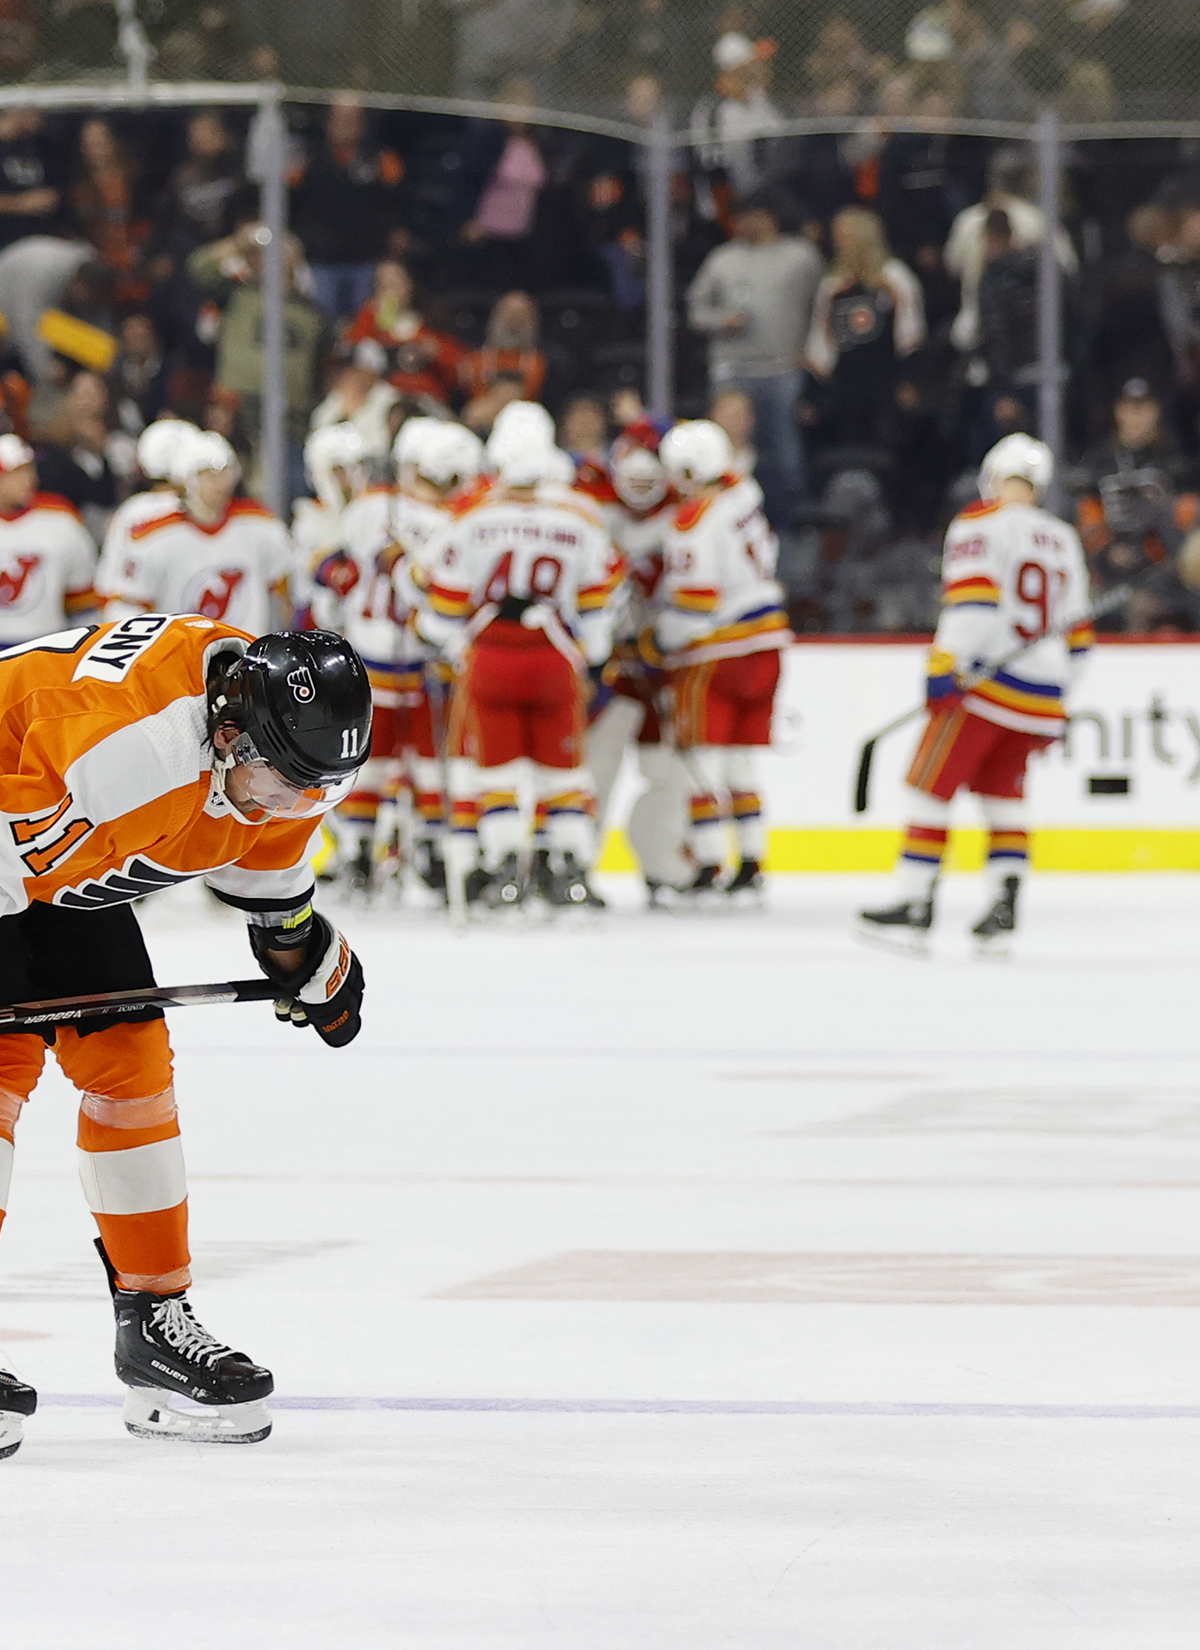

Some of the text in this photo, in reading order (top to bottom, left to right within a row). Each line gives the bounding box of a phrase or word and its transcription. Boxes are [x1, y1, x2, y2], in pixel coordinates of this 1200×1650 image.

[341, 728, 358, 759] 11
[9, 792, 94, 877] 11
[150, 1359, 189, 1384] BAUER
